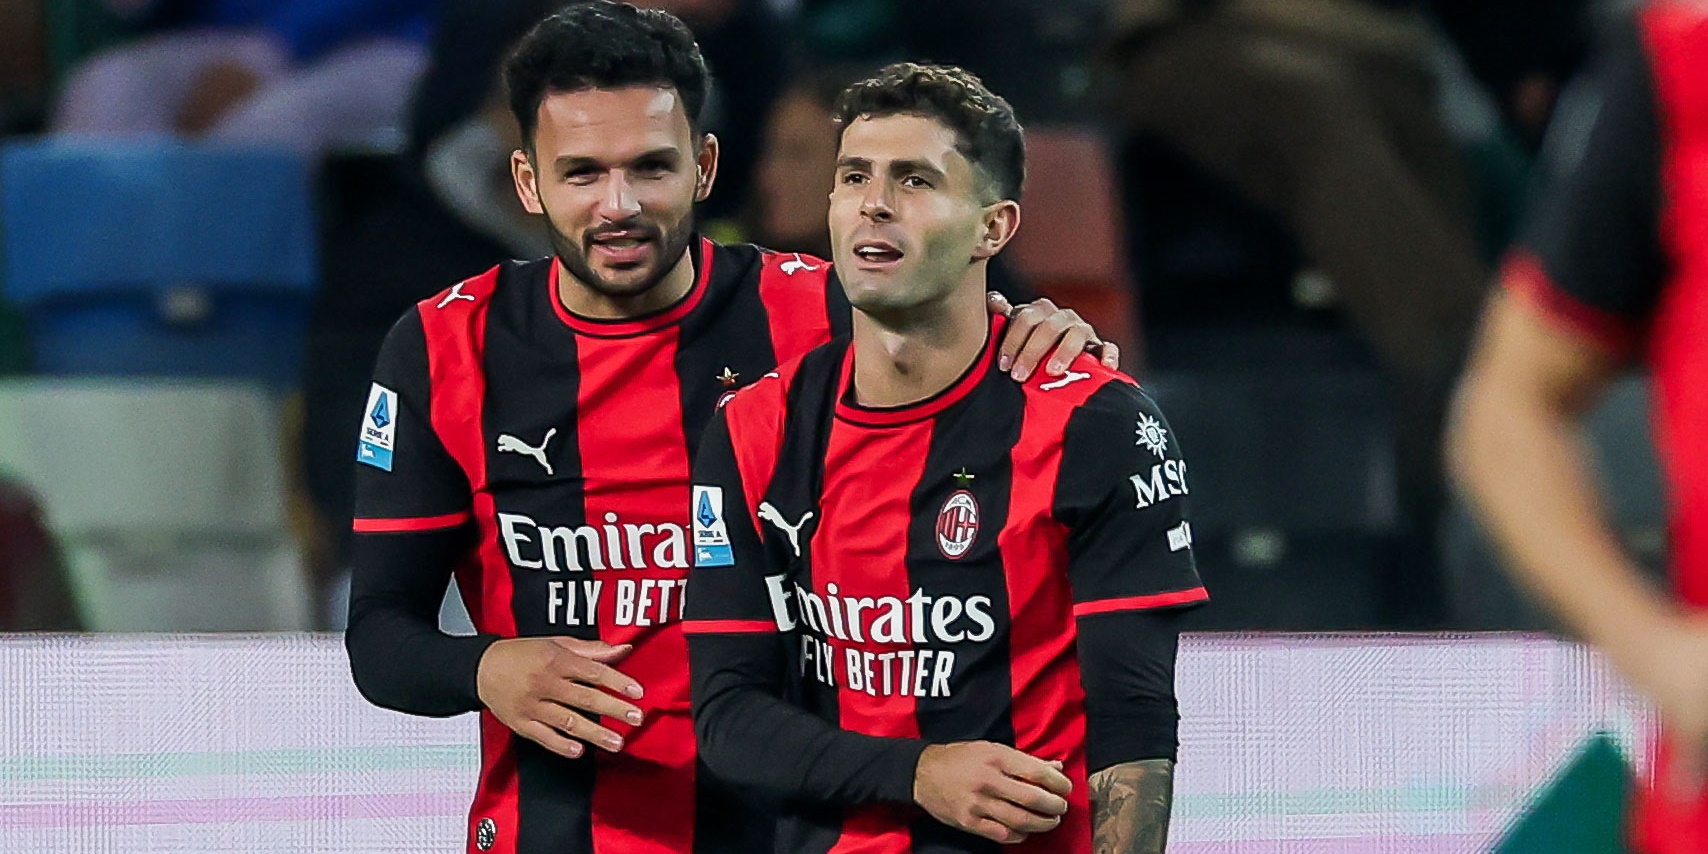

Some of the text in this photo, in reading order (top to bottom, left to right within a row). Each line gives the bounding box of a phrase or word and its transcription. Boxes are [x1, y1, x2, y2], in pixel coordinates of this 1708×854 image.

[498, 512, 691, 572] Emira
[548, 580, 602, 626] FLY
[764, 573, 996, 644] Emirates
[801, 634, 956, 697] FLY BETTER
